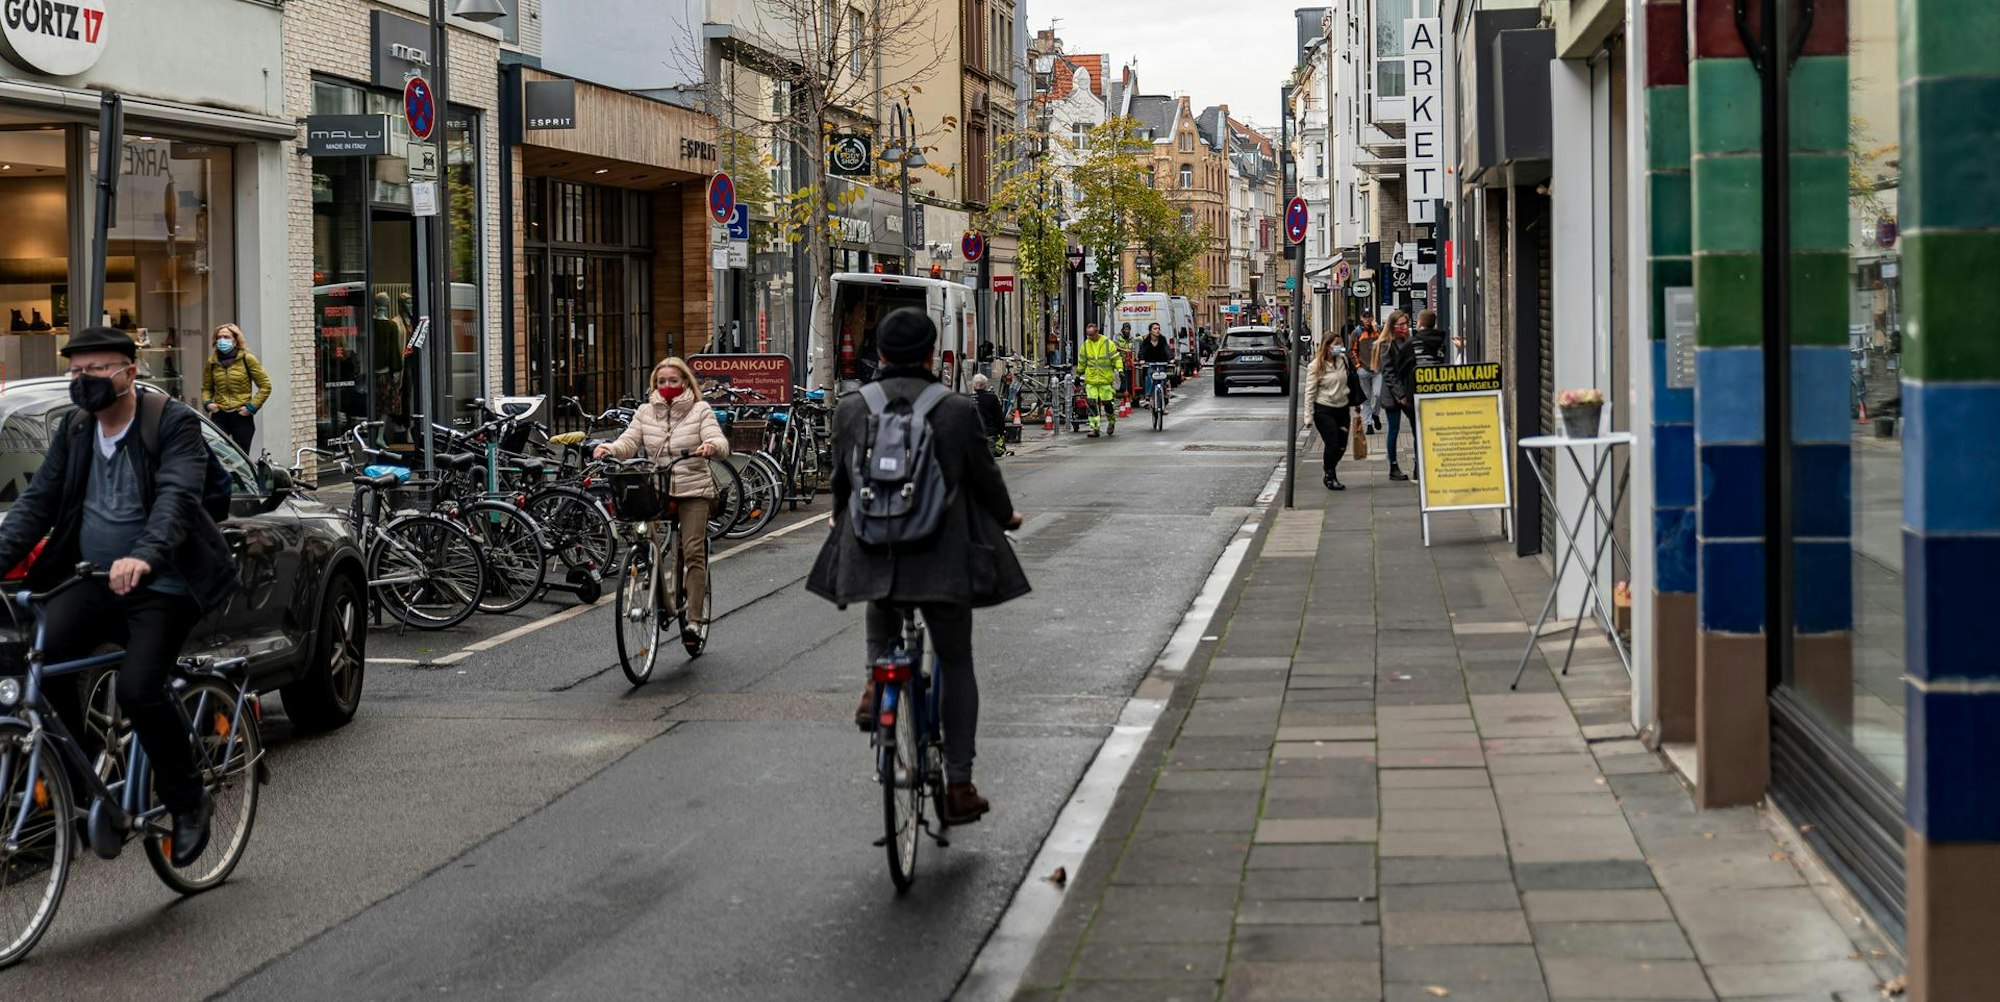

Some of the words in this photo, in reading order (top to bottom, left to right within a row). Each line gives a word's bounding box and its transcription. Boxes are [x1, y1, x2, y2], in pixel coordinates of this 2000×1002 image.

[83, 8, 104, 43] 17
[530, 118, 570, 126] ESPRIT
[310, 130, 381, 139] MALU
[680, 137, 717, 161] ESPRIT
[693, 360, 785, 371] GOLDANKAUF
[1415, 364, 1499, 383] GOLDANKAUF
[1416, 382, 1453, 393] SOFORT
[1456, 381, 1500, 391] BARGELD
